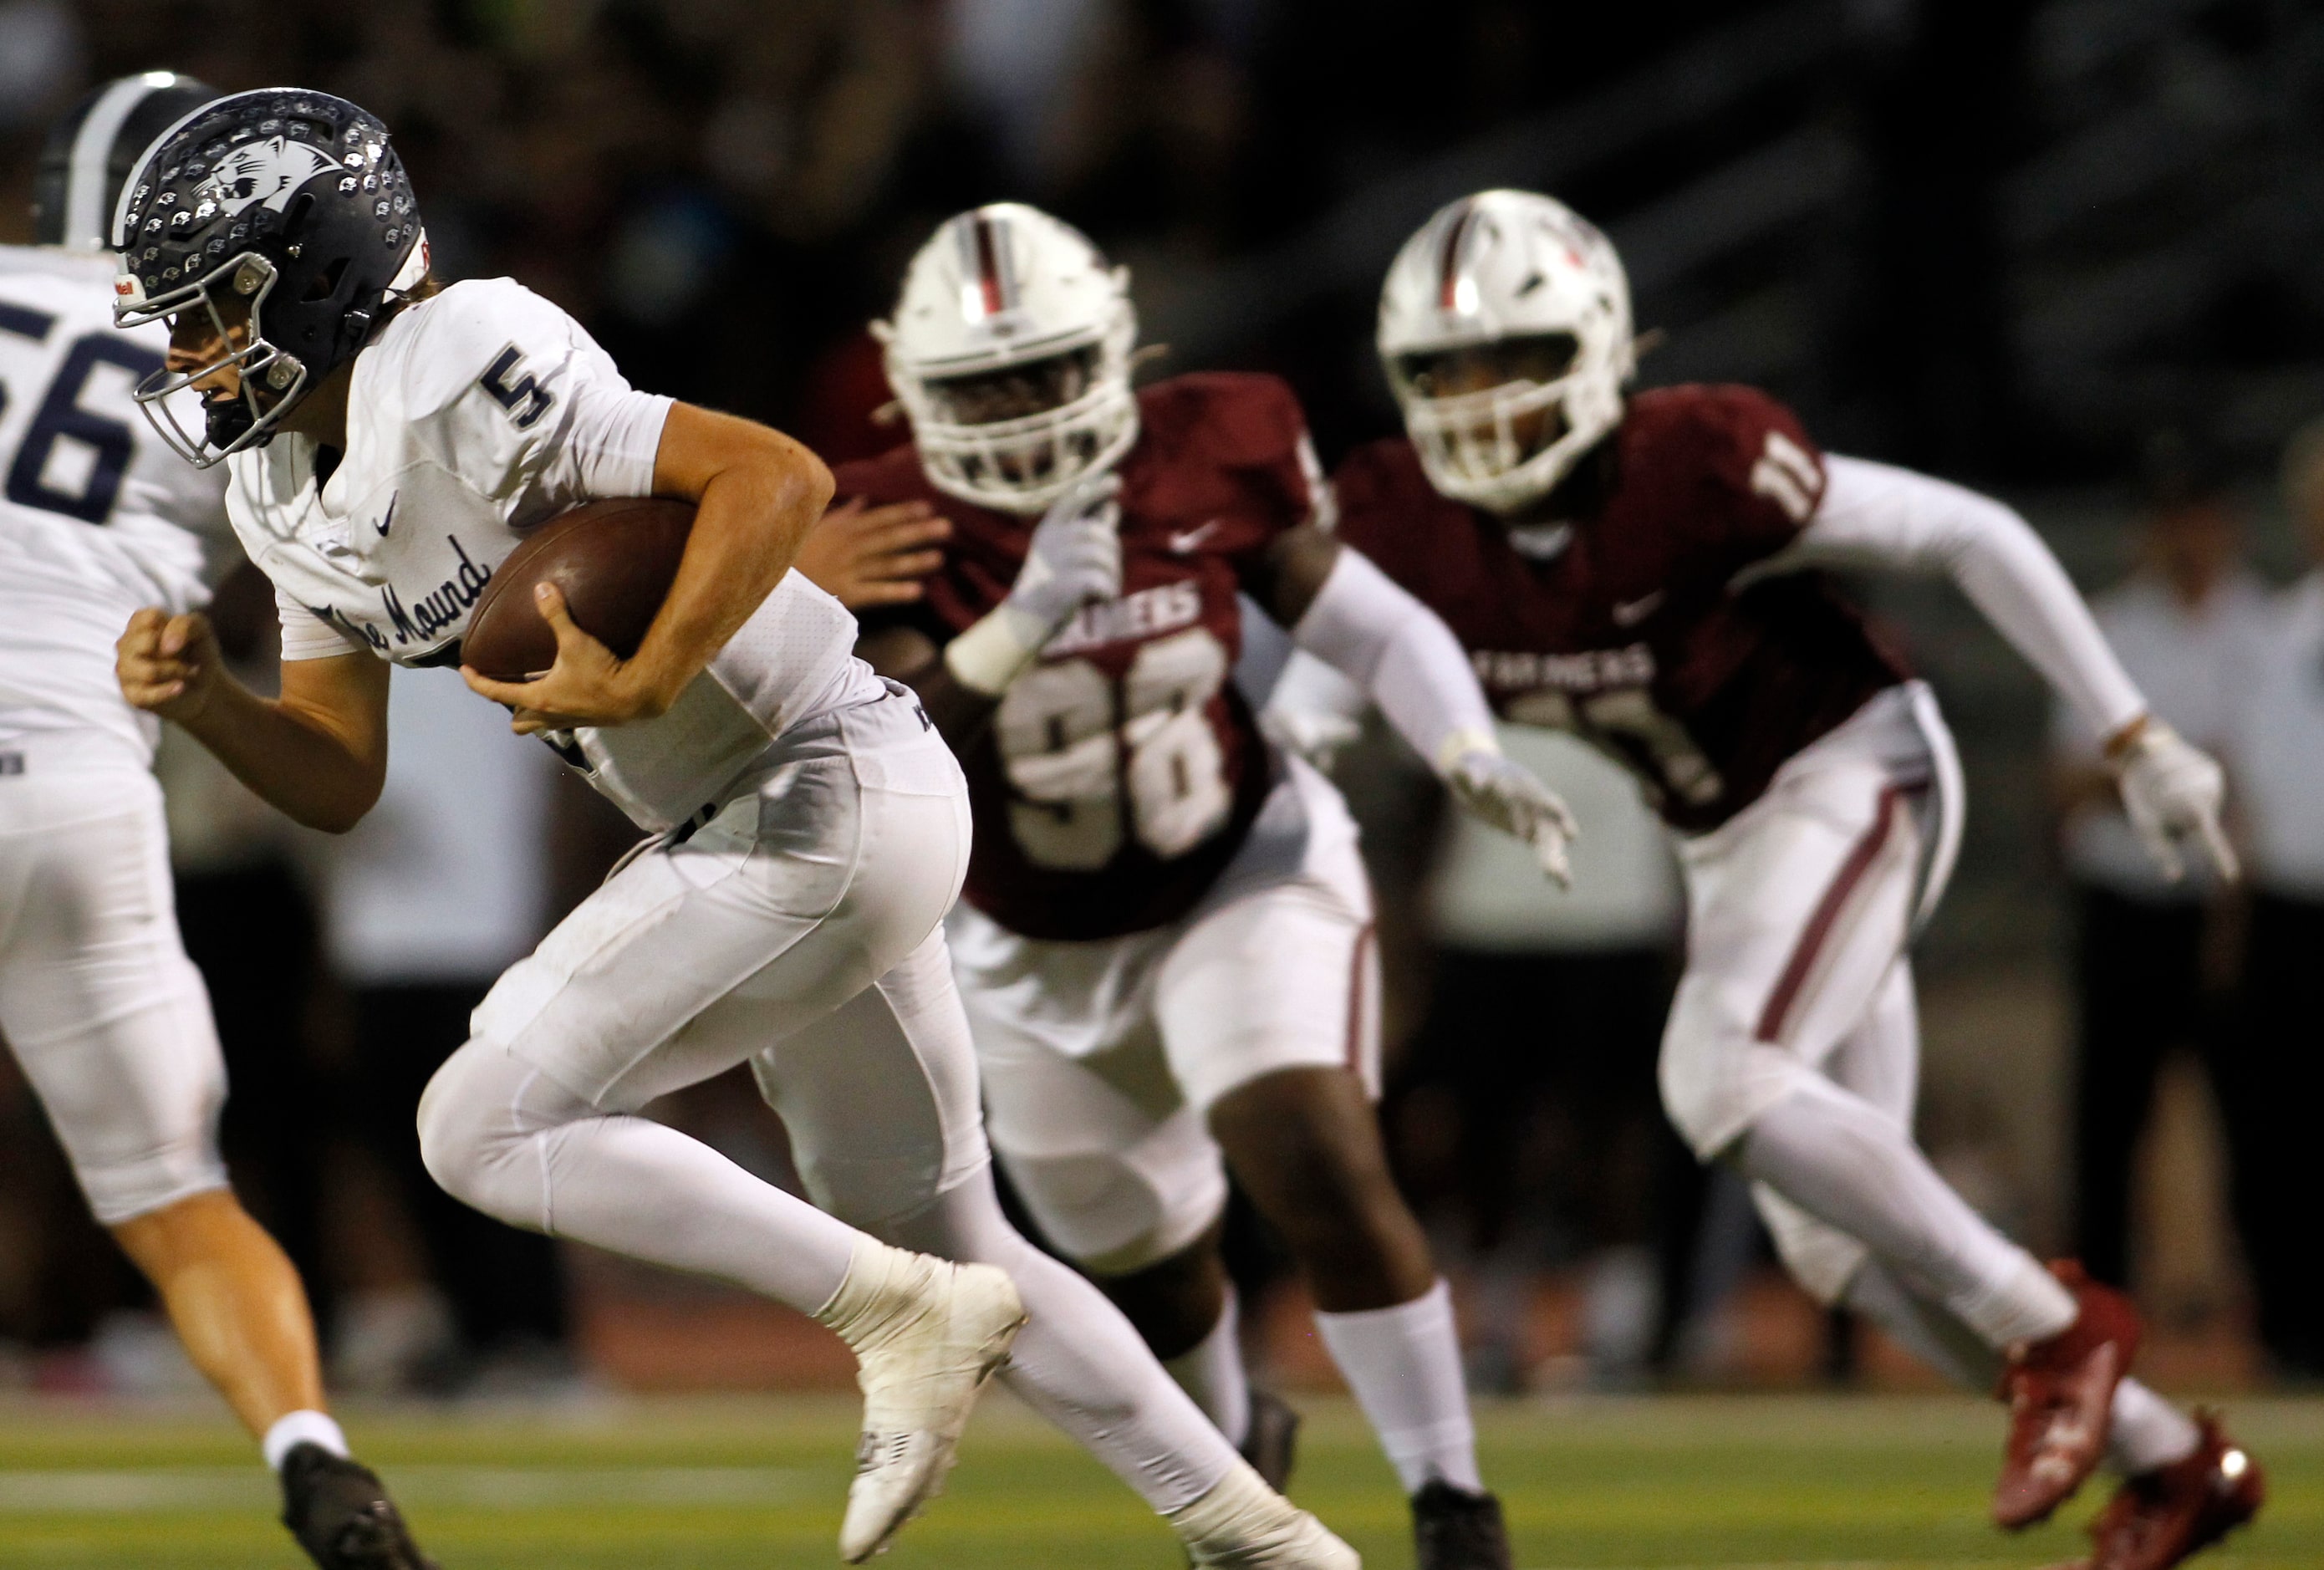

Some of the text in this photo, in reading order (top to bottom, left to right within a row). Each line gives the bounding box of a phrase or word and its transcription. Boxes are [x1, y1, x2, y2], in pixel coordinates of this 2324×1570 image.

[476, 340, 556, 431] 5
[381, 533, 492, 645] Mound
[996, 627, 1232, 873] 98
